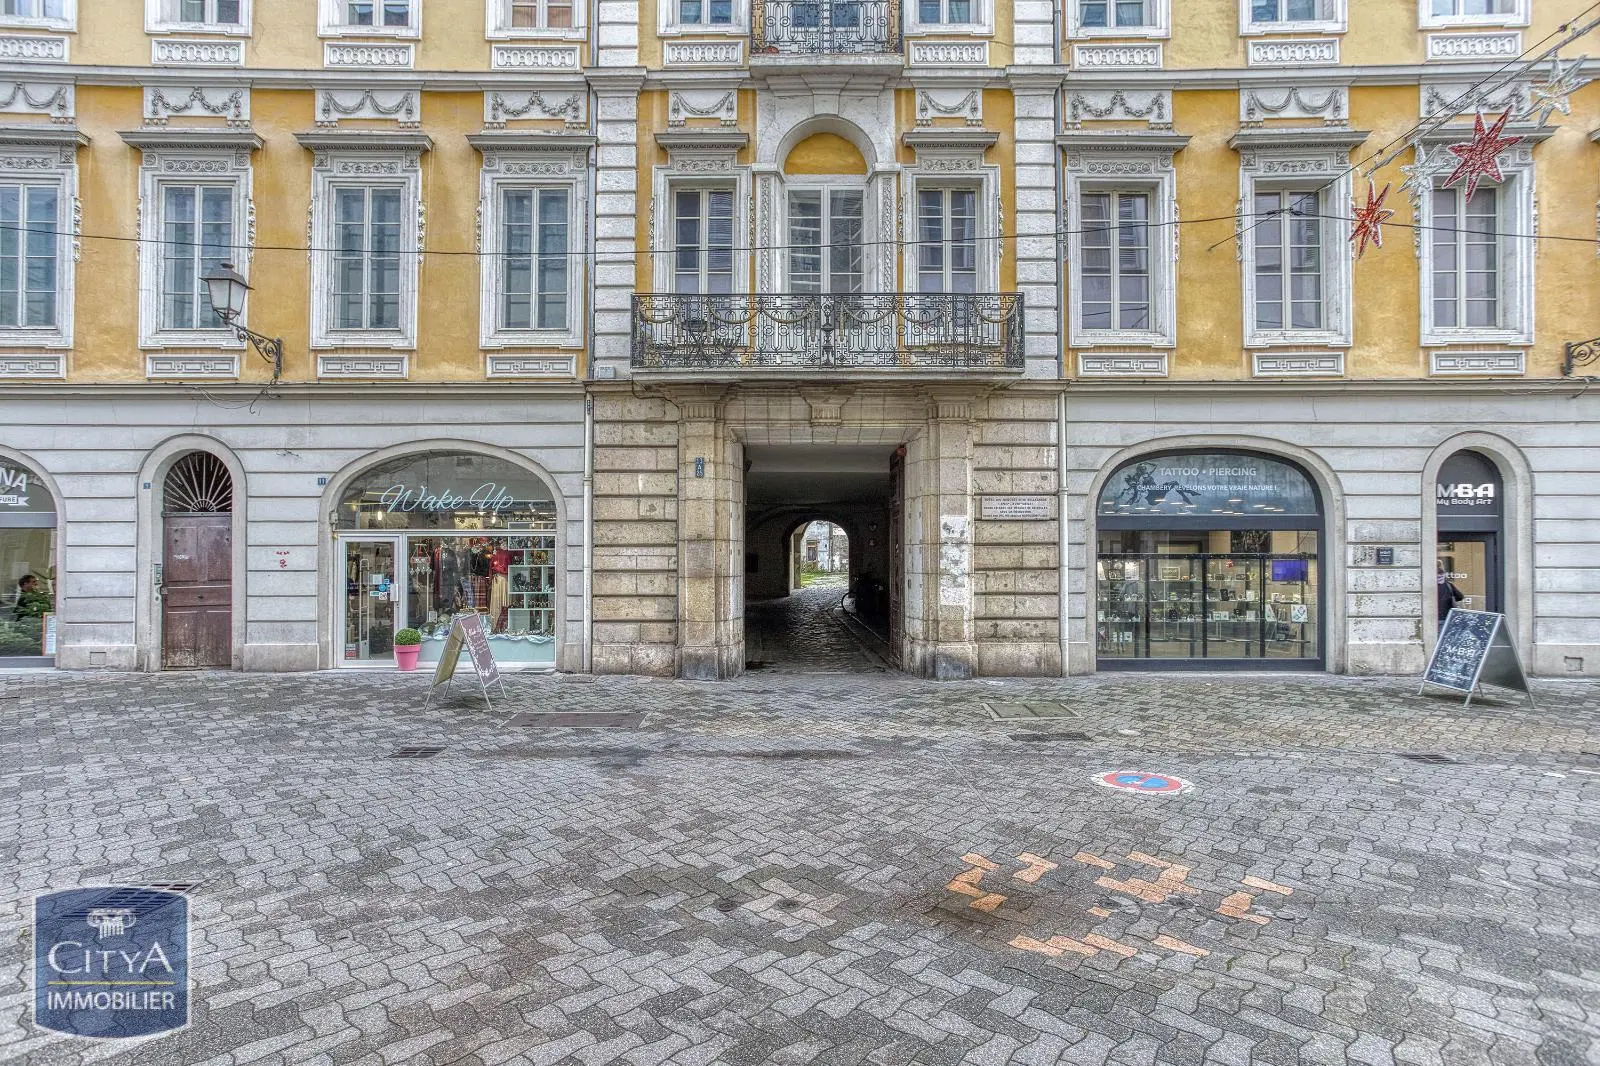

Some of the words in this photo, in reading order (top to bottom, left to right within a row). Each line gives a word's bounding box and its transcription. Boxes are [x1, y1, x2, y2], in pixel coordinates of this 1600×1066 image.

[1160, 467, 1200, 476] TATTOO
[1209, 467, 1257, 476] PIERCING
[381, 484, 465, 513] Wake
[469, 482, 514, 512] Up
[1436, 498, 1449, 506] My
[1451, 498, 1474, 506] Body
[1445, 571, 1468, 579] ttoo
